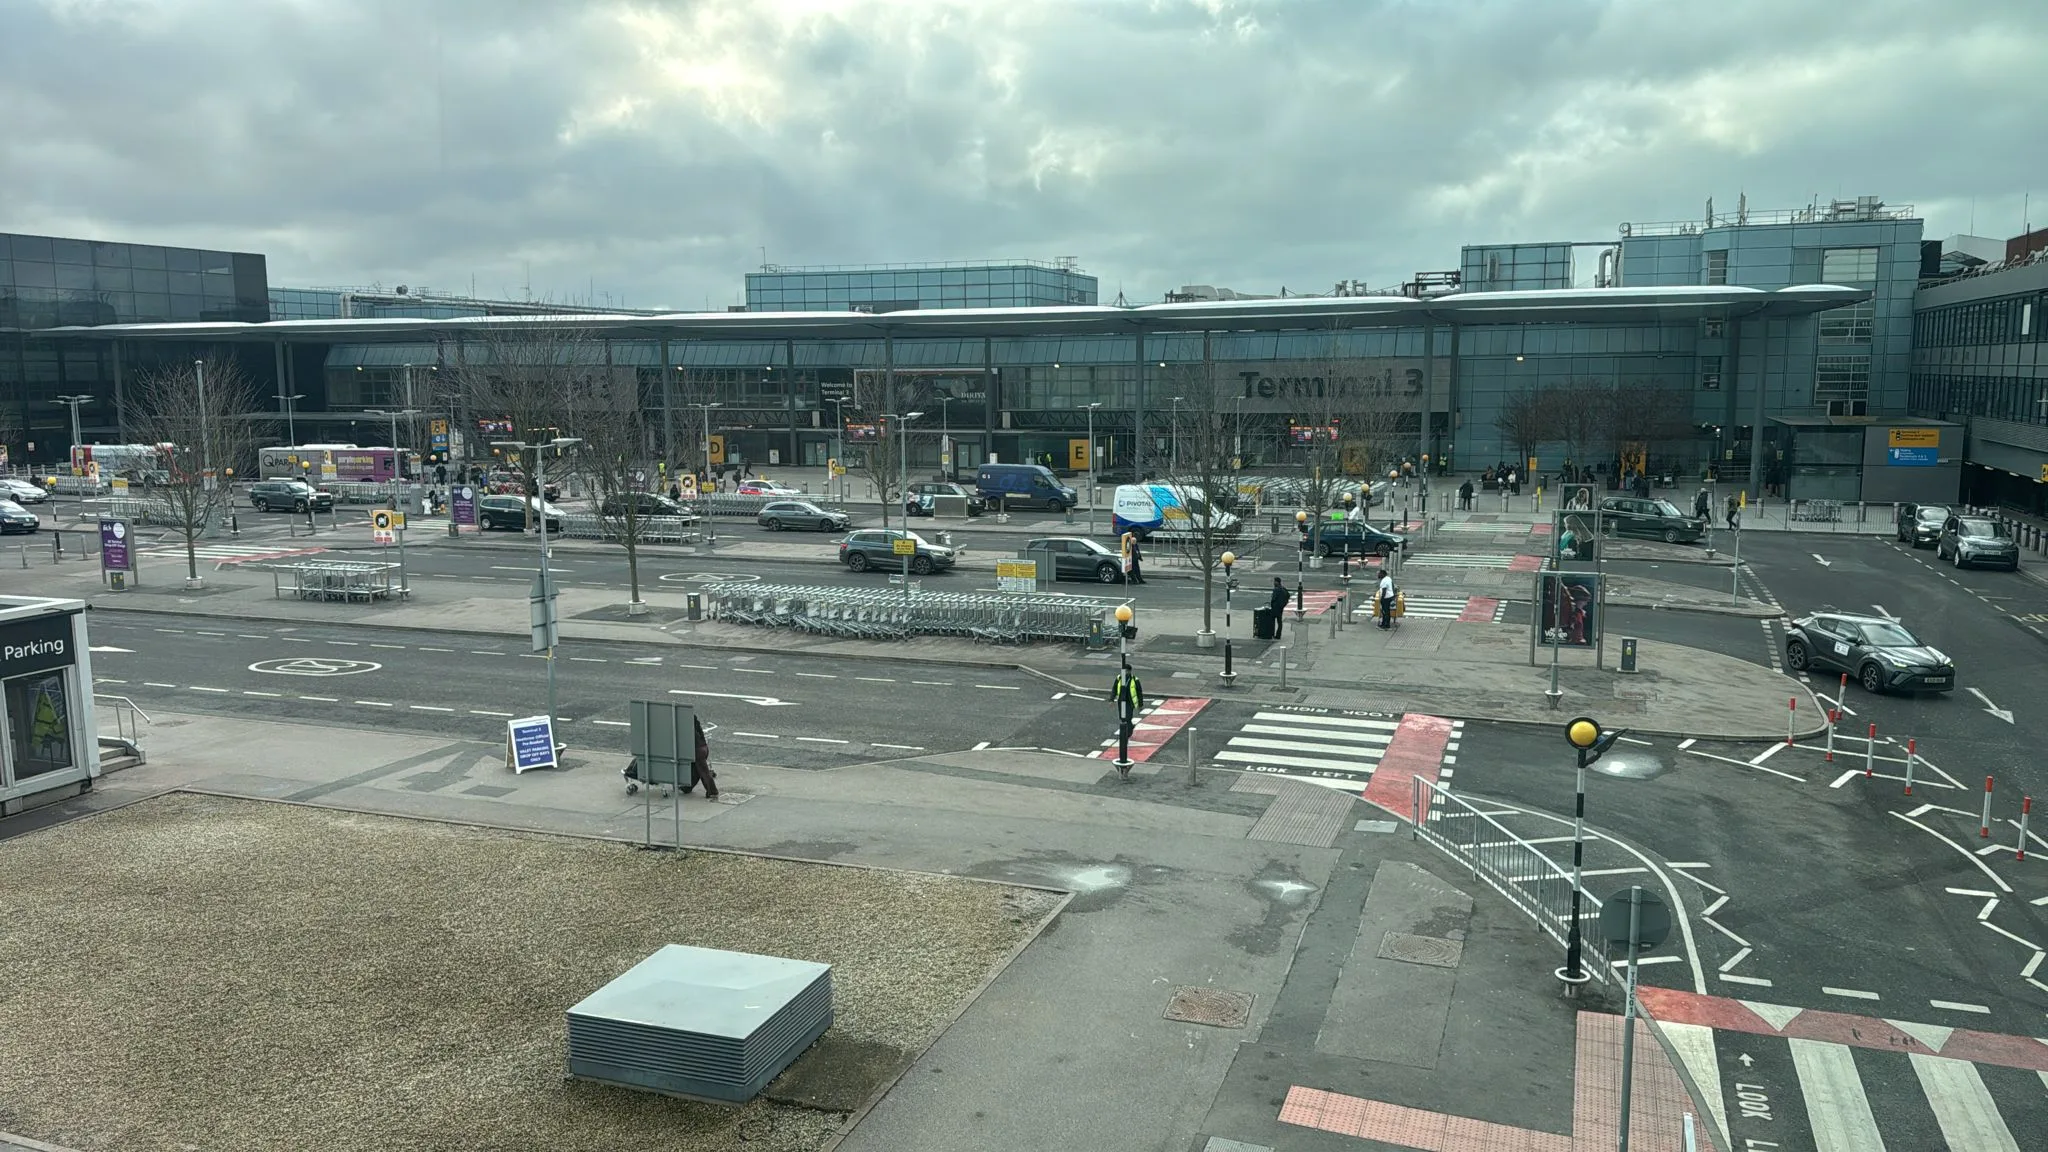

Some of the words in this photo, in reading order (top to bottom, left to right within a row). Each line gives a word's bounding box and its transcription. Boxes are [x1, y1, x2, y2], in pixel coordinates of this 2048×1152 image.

[1404, 368, 1424, 397] 3
[710, 441, 720, 454] D
[1075, 446, 1084, 460] E
[4, 639, 64, 660] Parking
[1274, 705, 1328, 713] RIGHT
[1342, 710, 1394, 718] LOOK
[1245, 765, 1288, 774] LOOK
[1311, 770, 1358, 779] LEFT
[1736, 1083, 1773, 1120] LOOK
